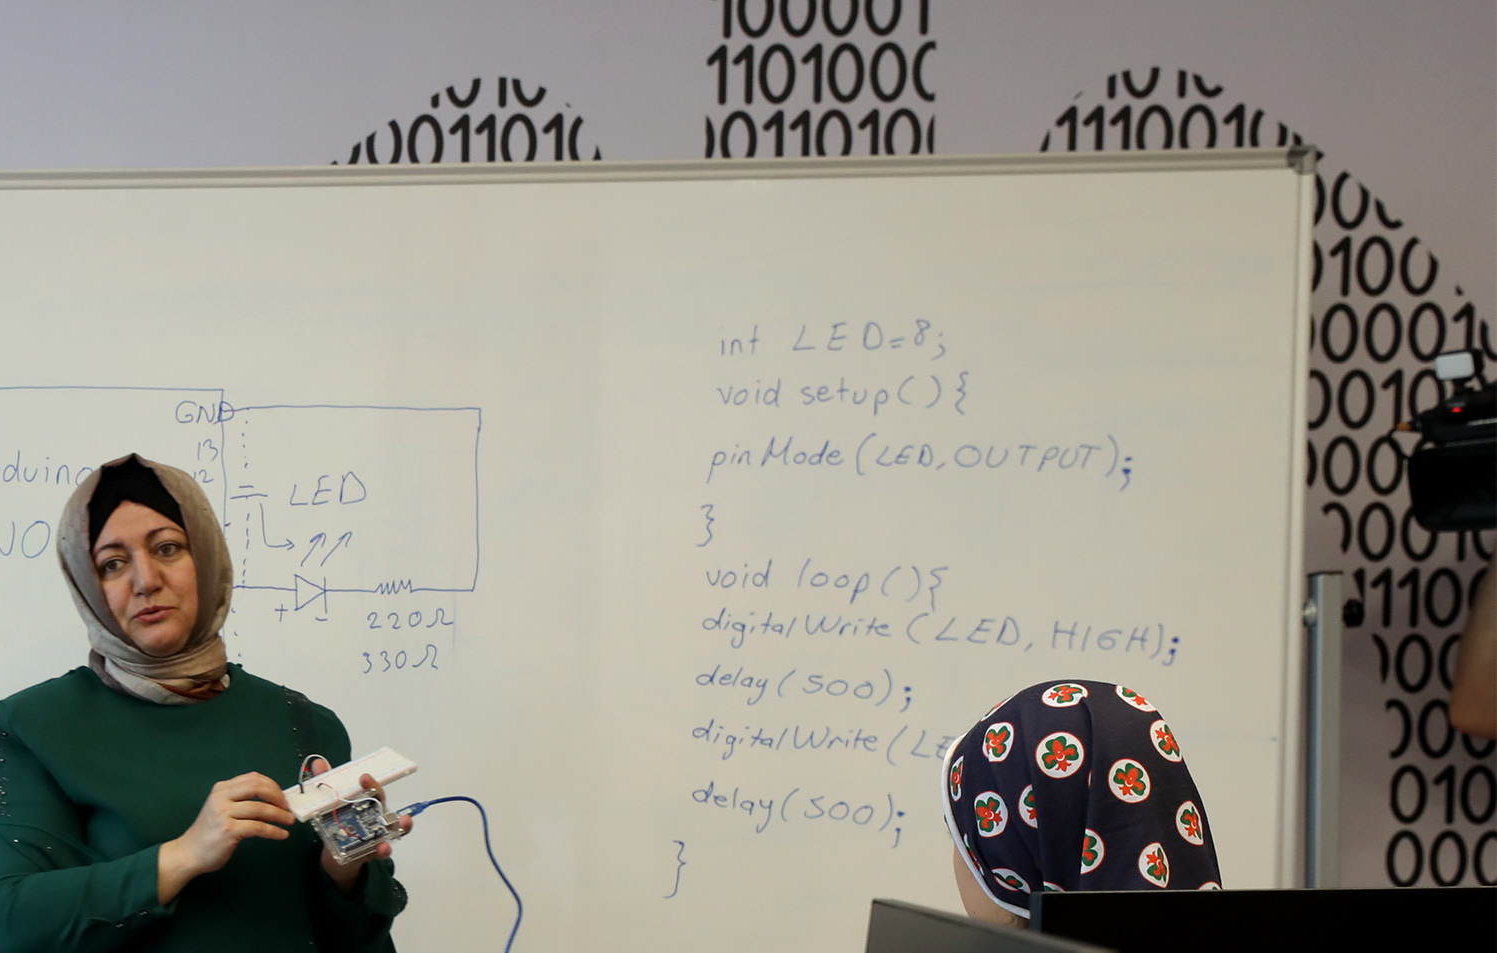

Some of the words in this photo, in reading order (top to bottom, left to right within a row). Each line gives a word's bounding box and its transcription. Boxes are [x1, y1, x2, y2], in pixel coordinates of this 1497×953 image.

[719, 324, 759, 357] int
[717, 378, 780, 408] void
[197, 438, 219, 462] 13
[289, 470, 368, 507] LED
[705, 559, 773, 590] void
